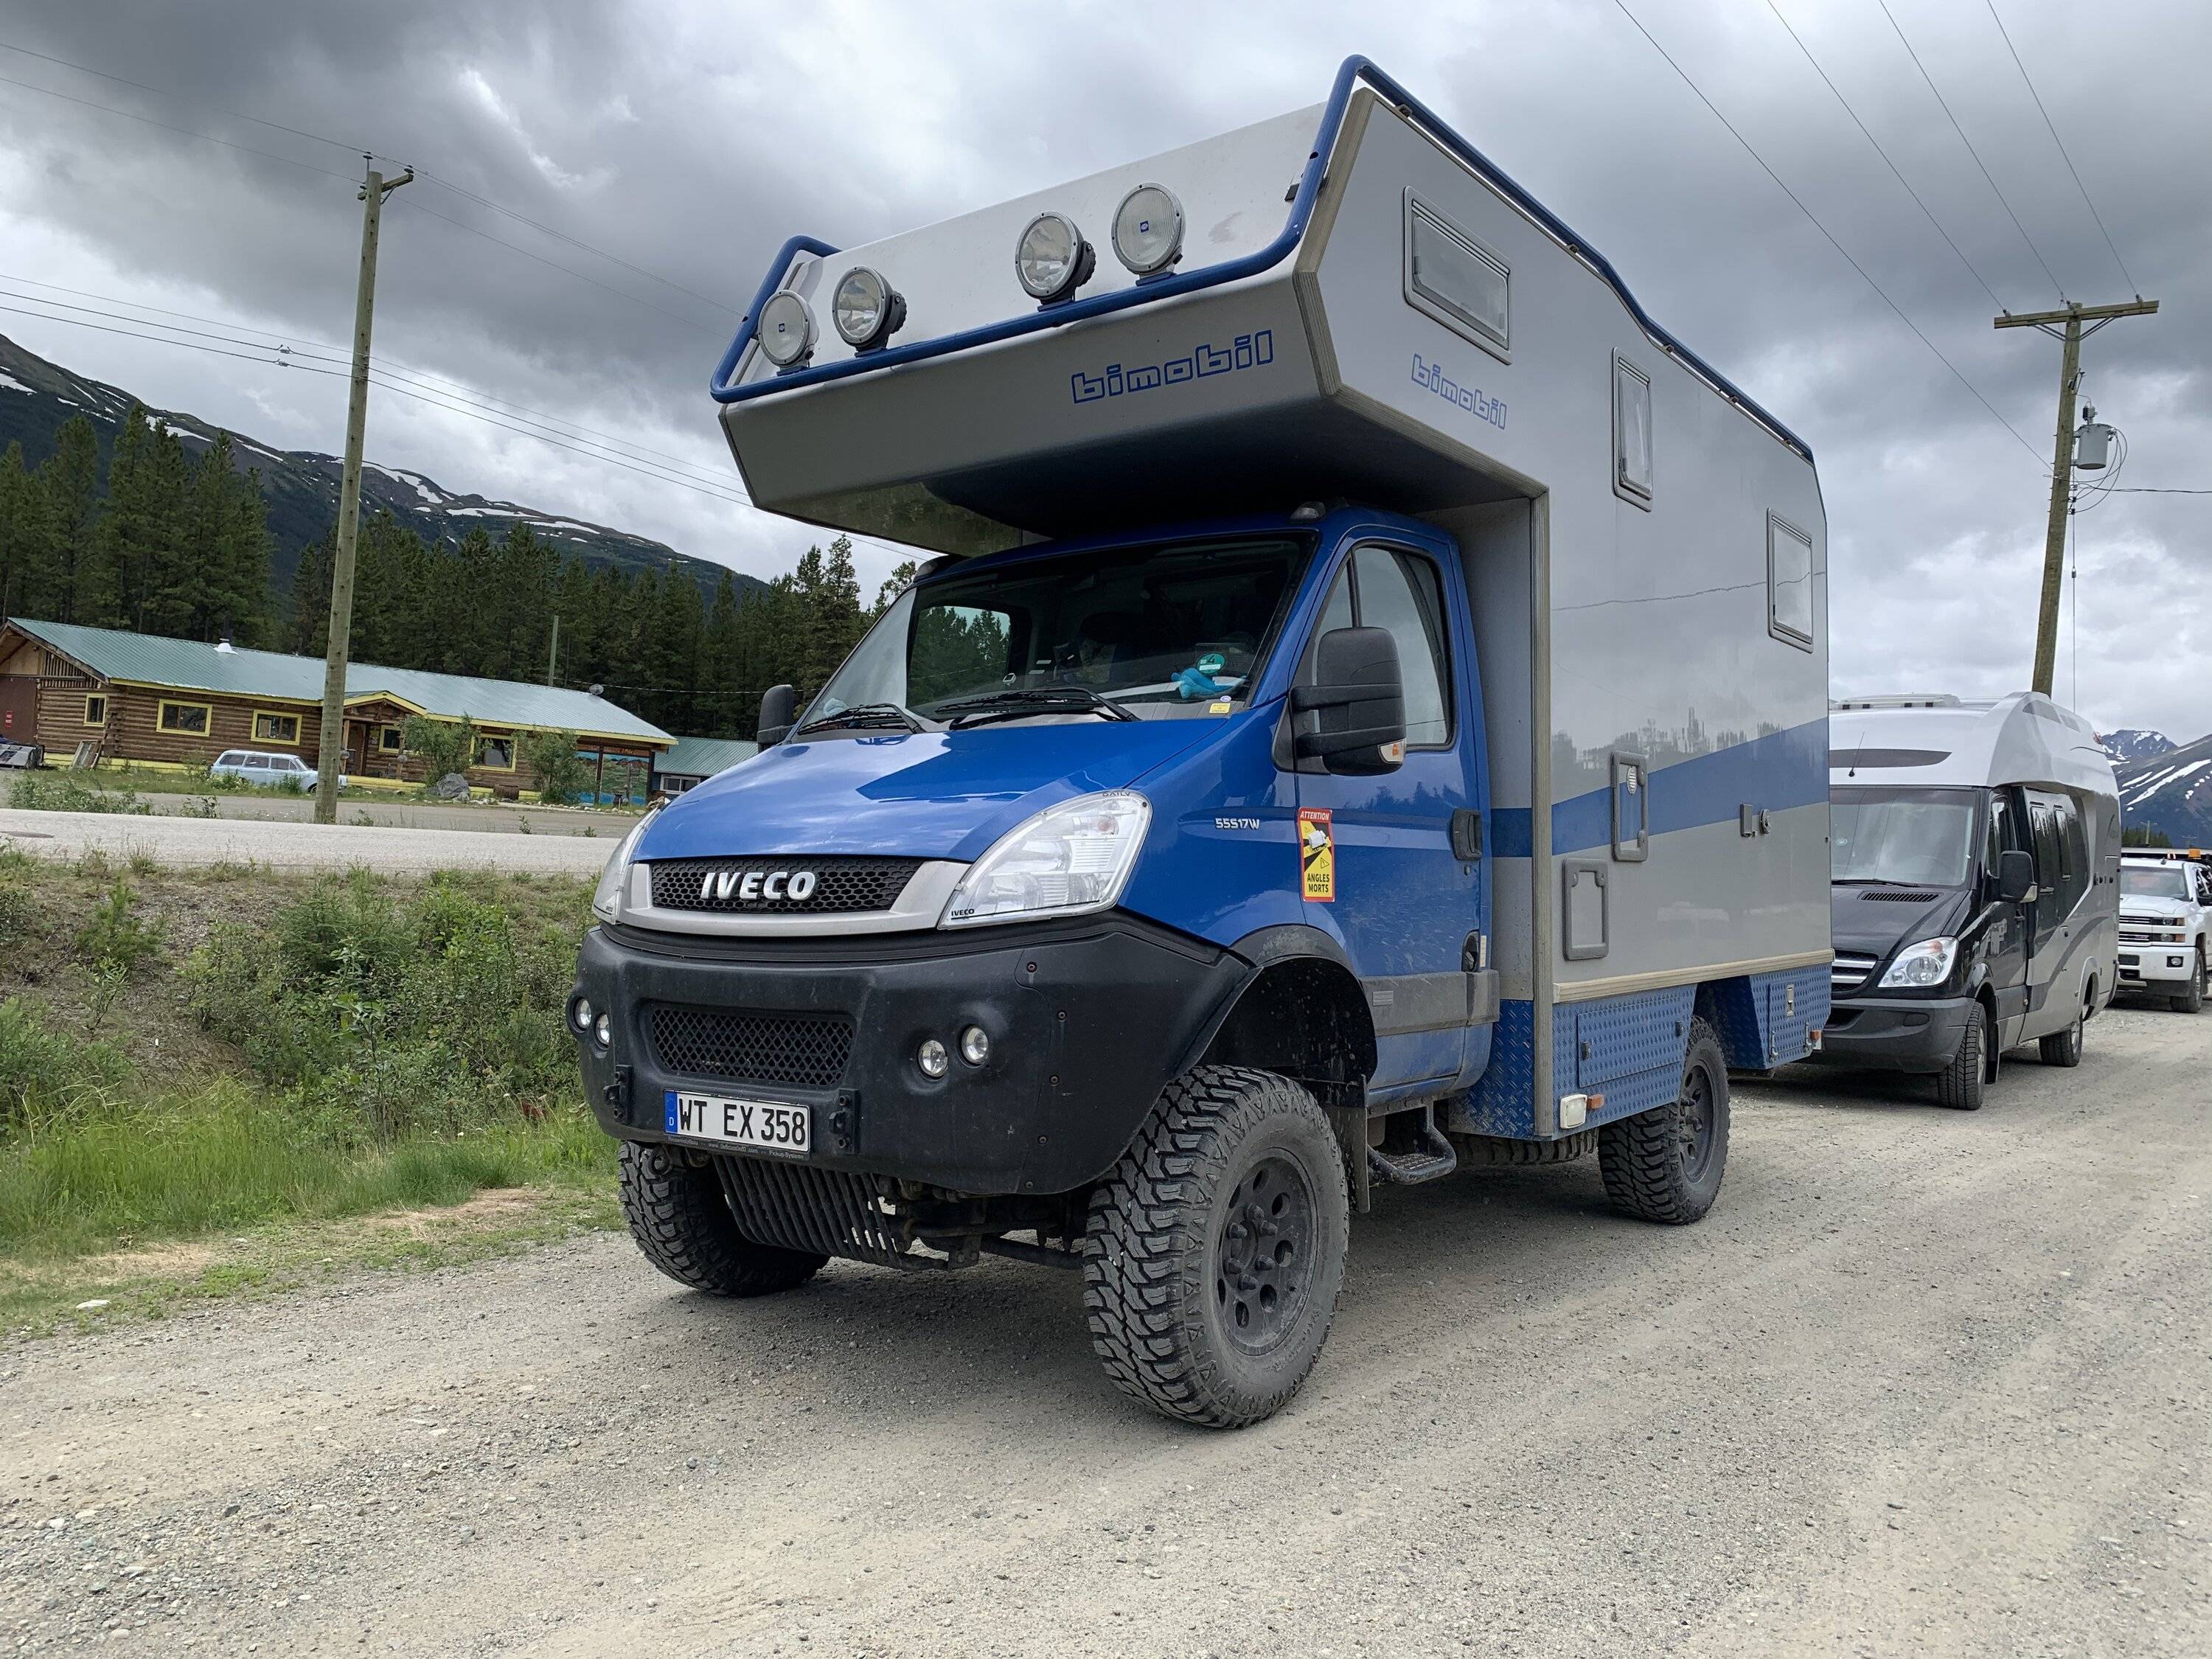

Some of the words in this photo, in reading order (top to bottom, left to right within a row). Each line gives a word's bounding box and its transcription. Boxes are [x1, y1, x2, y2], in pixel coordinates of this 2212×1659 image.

[1071, 330, 1274, 404] bimobil
[1411, 352, 1507, 431] bimobil
[1206, 654, 1216, 663] 4
[1300, 810, 1329, 821] ATTENTION
[1214, 818, 1260, 830] 55S17W
[1307, 873, 1330, 883] ANGLES
[700, 872, 815, 900] IVECO
[1308, 883, 1329, 893] MORTS
[951, 908, 975, 917] IVECO
[669, 1116, 675, 1126] D
[678, 1098, 708, 1133] WT
[723, 1103, 754, 1139] EX
[760, 1107, 806, 1146] 358
